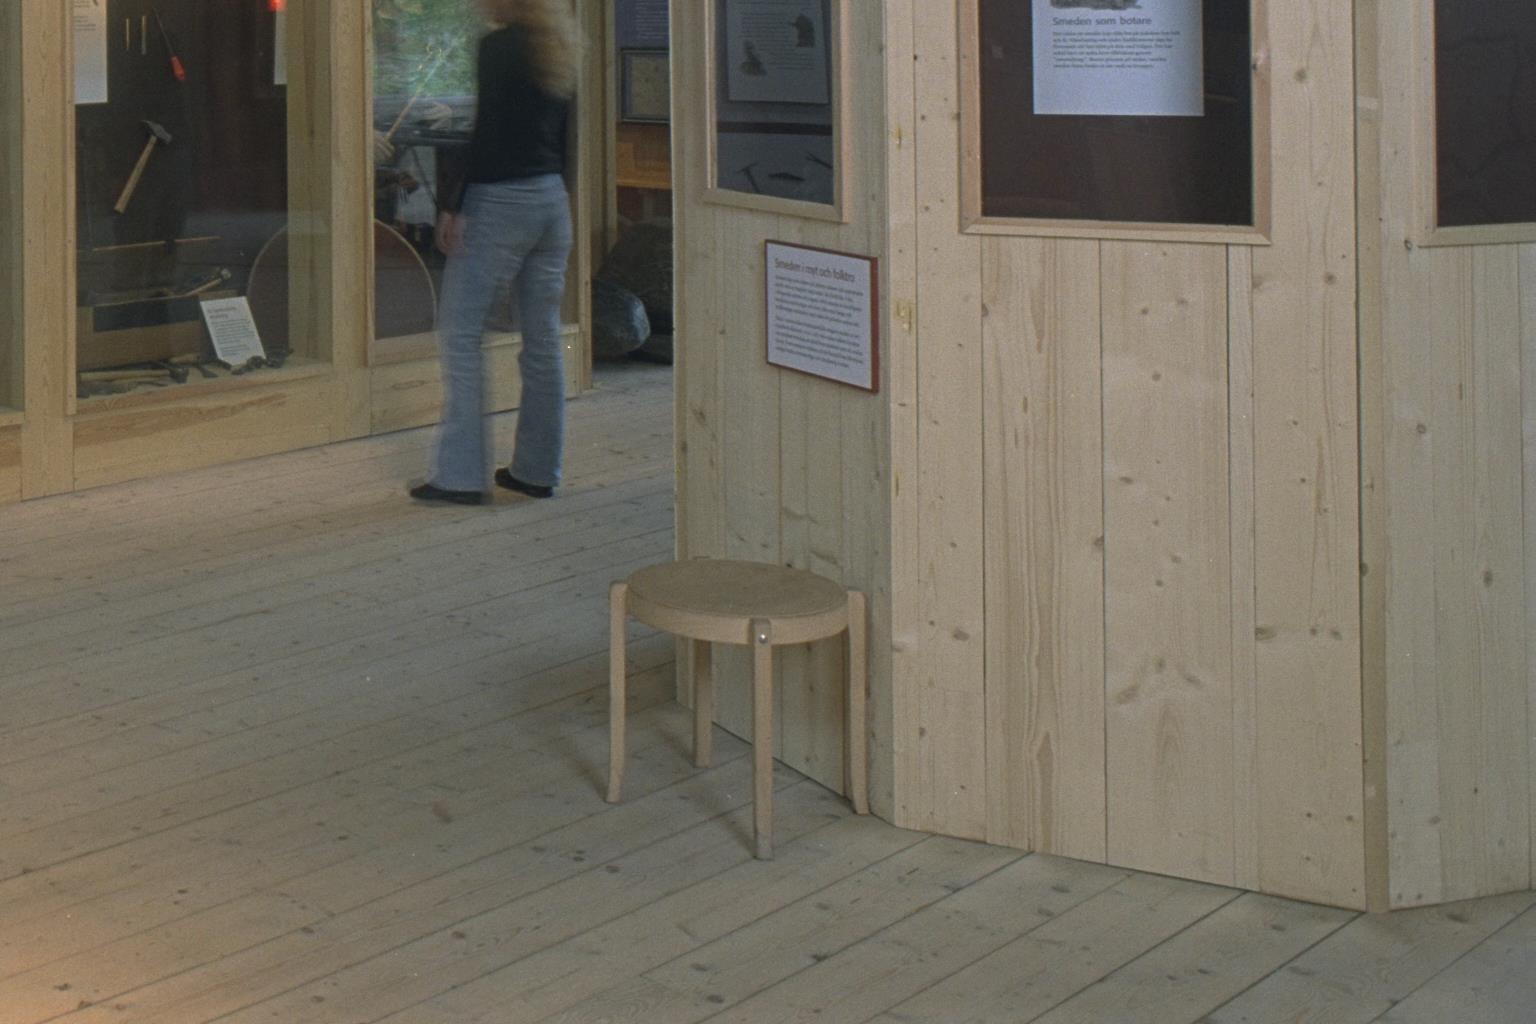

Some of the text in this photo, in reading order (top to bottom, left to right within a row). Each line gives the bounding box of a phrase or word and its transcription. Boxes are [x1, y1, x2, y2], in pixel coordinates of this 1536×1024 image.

[1052, 16, 1153, 26] Smeden som botare
[775, 258, 801, 272] Smeden
[806, 266, 818, 277] myt
[819, 266, 832, 278] och
[833, 268, 855, 283] folktro
